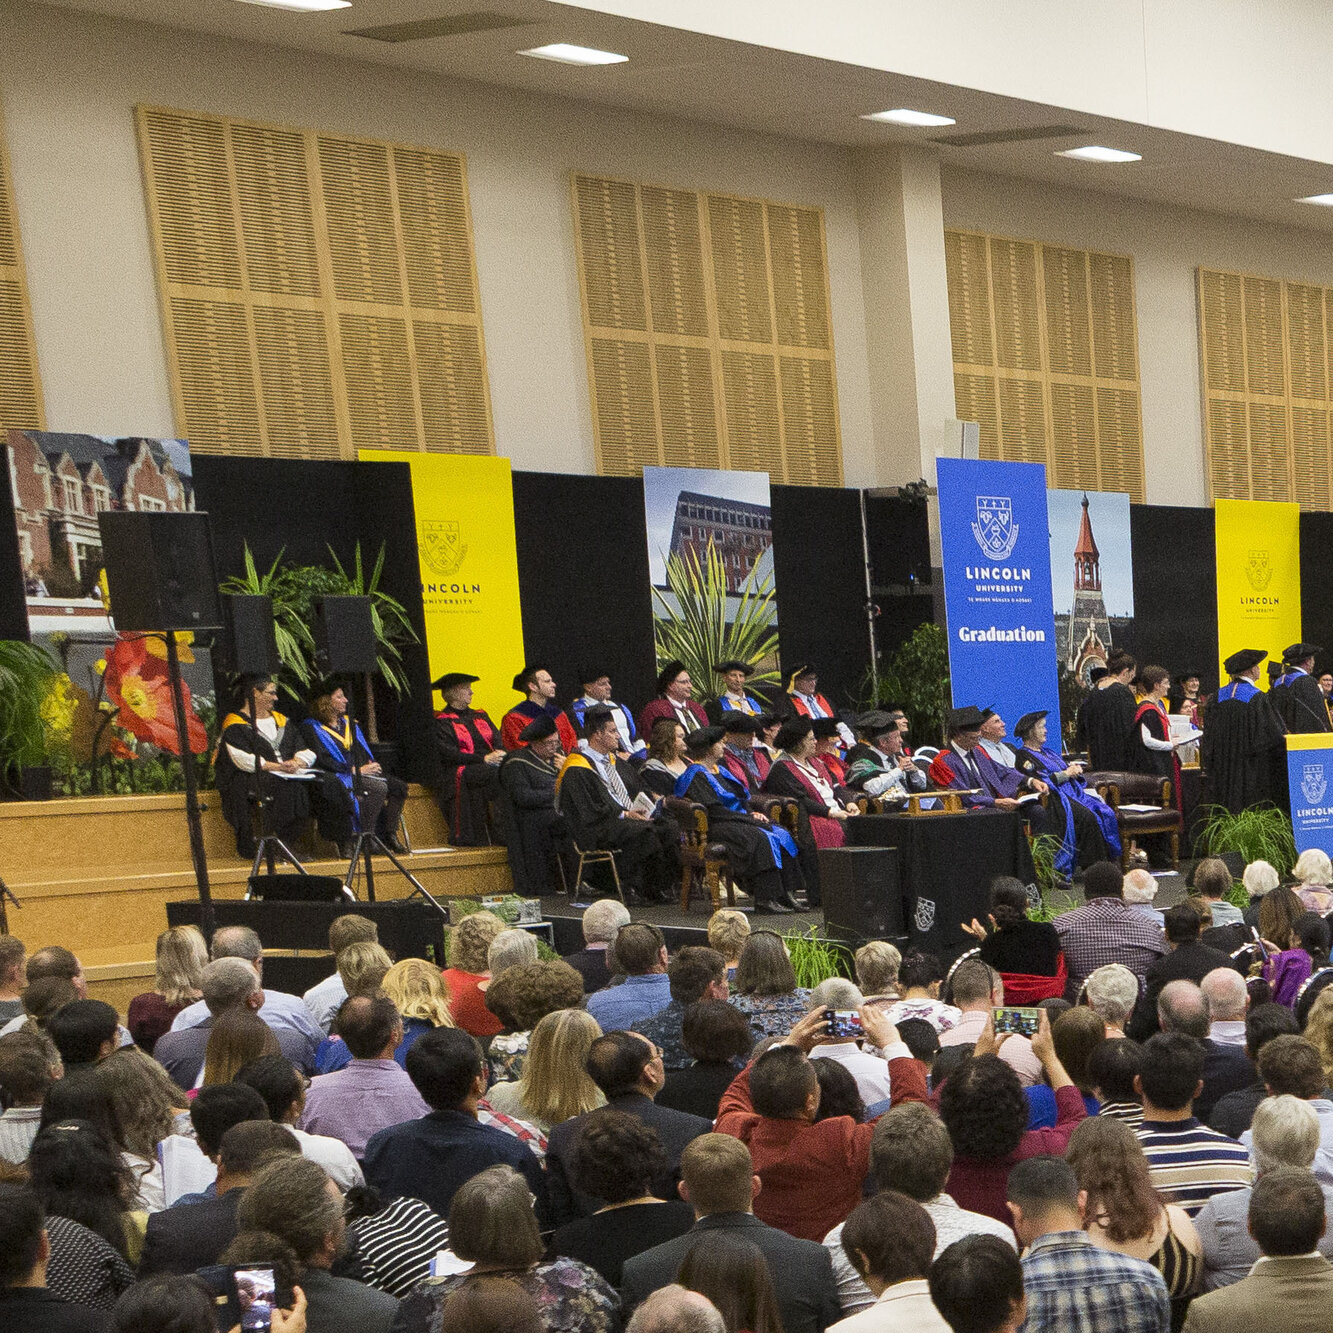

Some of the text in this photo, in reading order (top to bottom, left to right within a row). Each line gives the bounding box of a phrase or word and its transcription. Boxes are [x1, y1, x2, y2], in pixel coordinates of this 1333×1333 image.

[965, 566, 1031, 580] LINCOLN
[421, 584, 480, 593] INCOLN
[959, 625, 1045, 642] Graduation
[1297, 807, 1333, 817] LINCOLN
